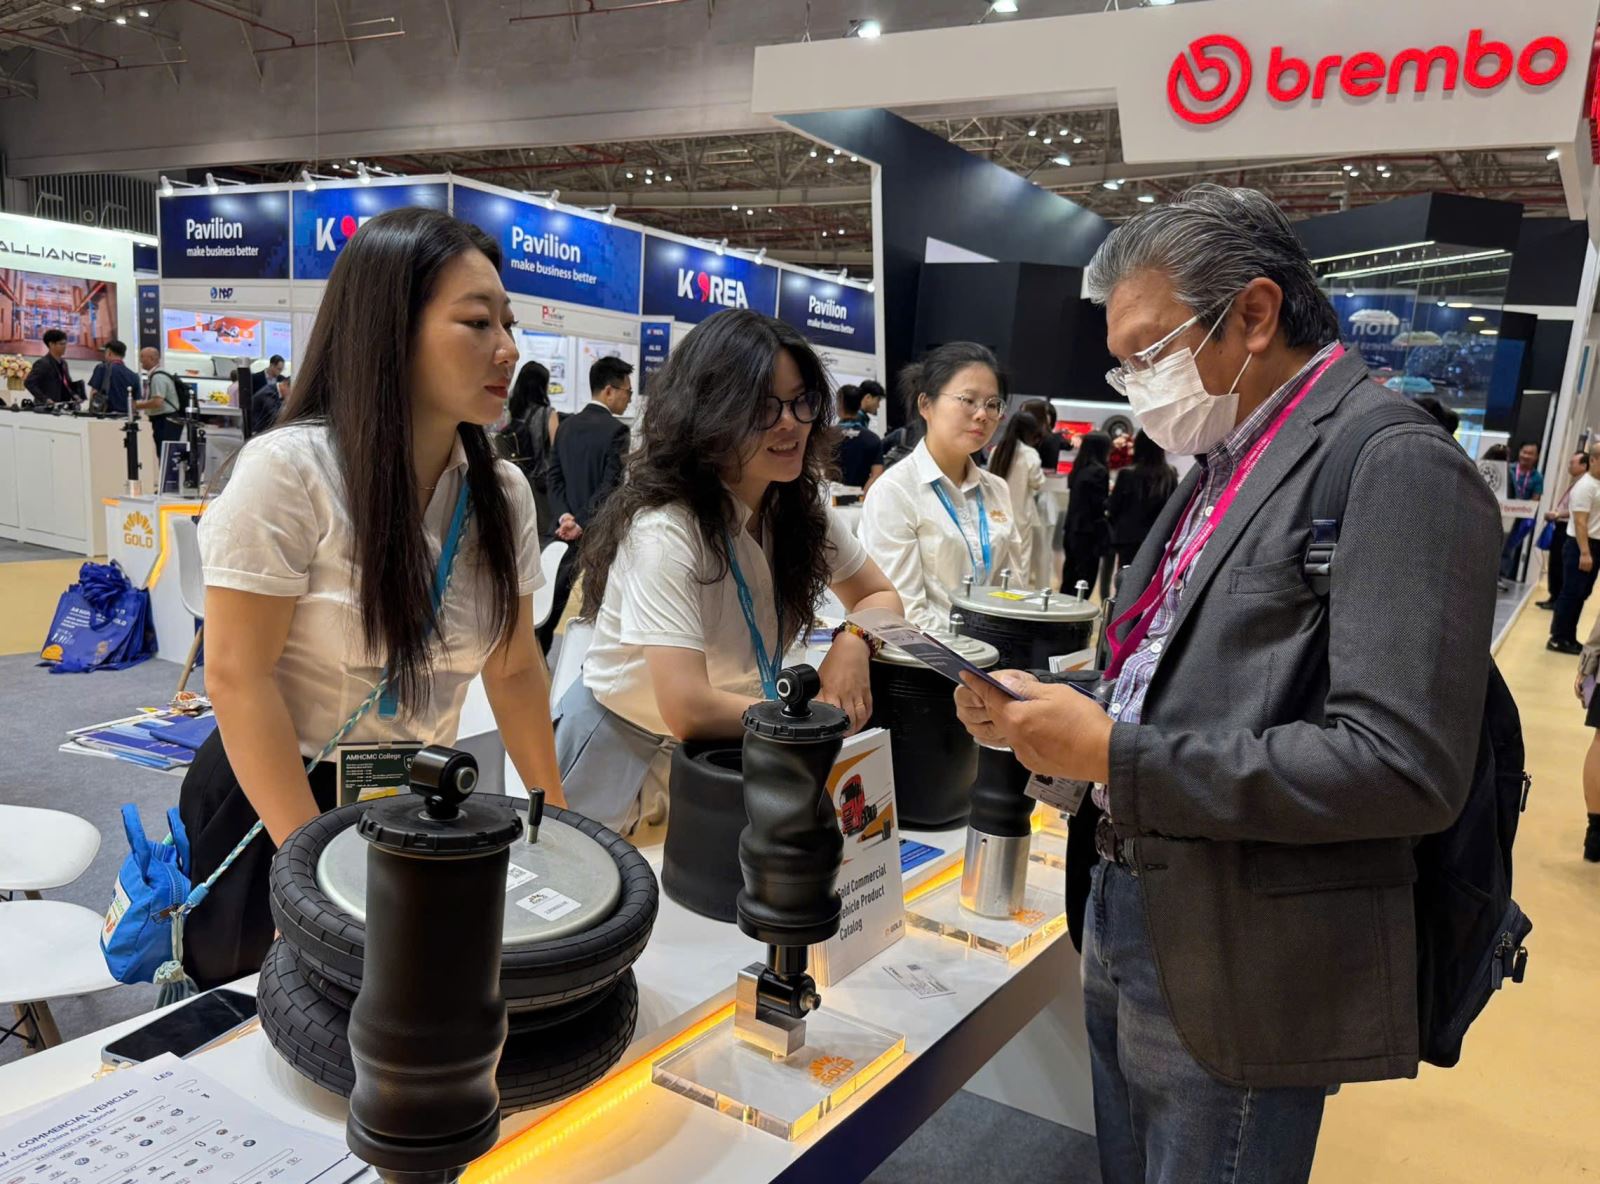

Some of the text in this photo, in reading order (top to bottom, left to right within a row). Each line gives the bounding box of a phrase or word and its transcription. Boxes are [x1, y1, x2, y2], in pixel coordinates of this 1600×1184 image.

[1266, 29, 1568, 101] brembo
[186, 217, 243, 240] Pavilion
[0, 241, 102, 266] ALLIANCE
[186, 245, 259, 256] make business better
[512, 226, 581, 263] Pavilion
[511, 258, 597, 285] make business better
[808, 295, 847, 320] Pavilion
[124, 532, 153, 549] GOLD
[378, 752, 401, 760] College
[851, 863, 887, 892] Commercial
[860, 883, 885, 907] Product
[840, 918, 863, 941] Catalog
[18, 1114, 90, 1149] COMMERCIAL
[89, 1088, 138, 1113] VEHICLES
[48, 1132, 69, 1143] China
[70, 1123, 88, 1133] Auto
